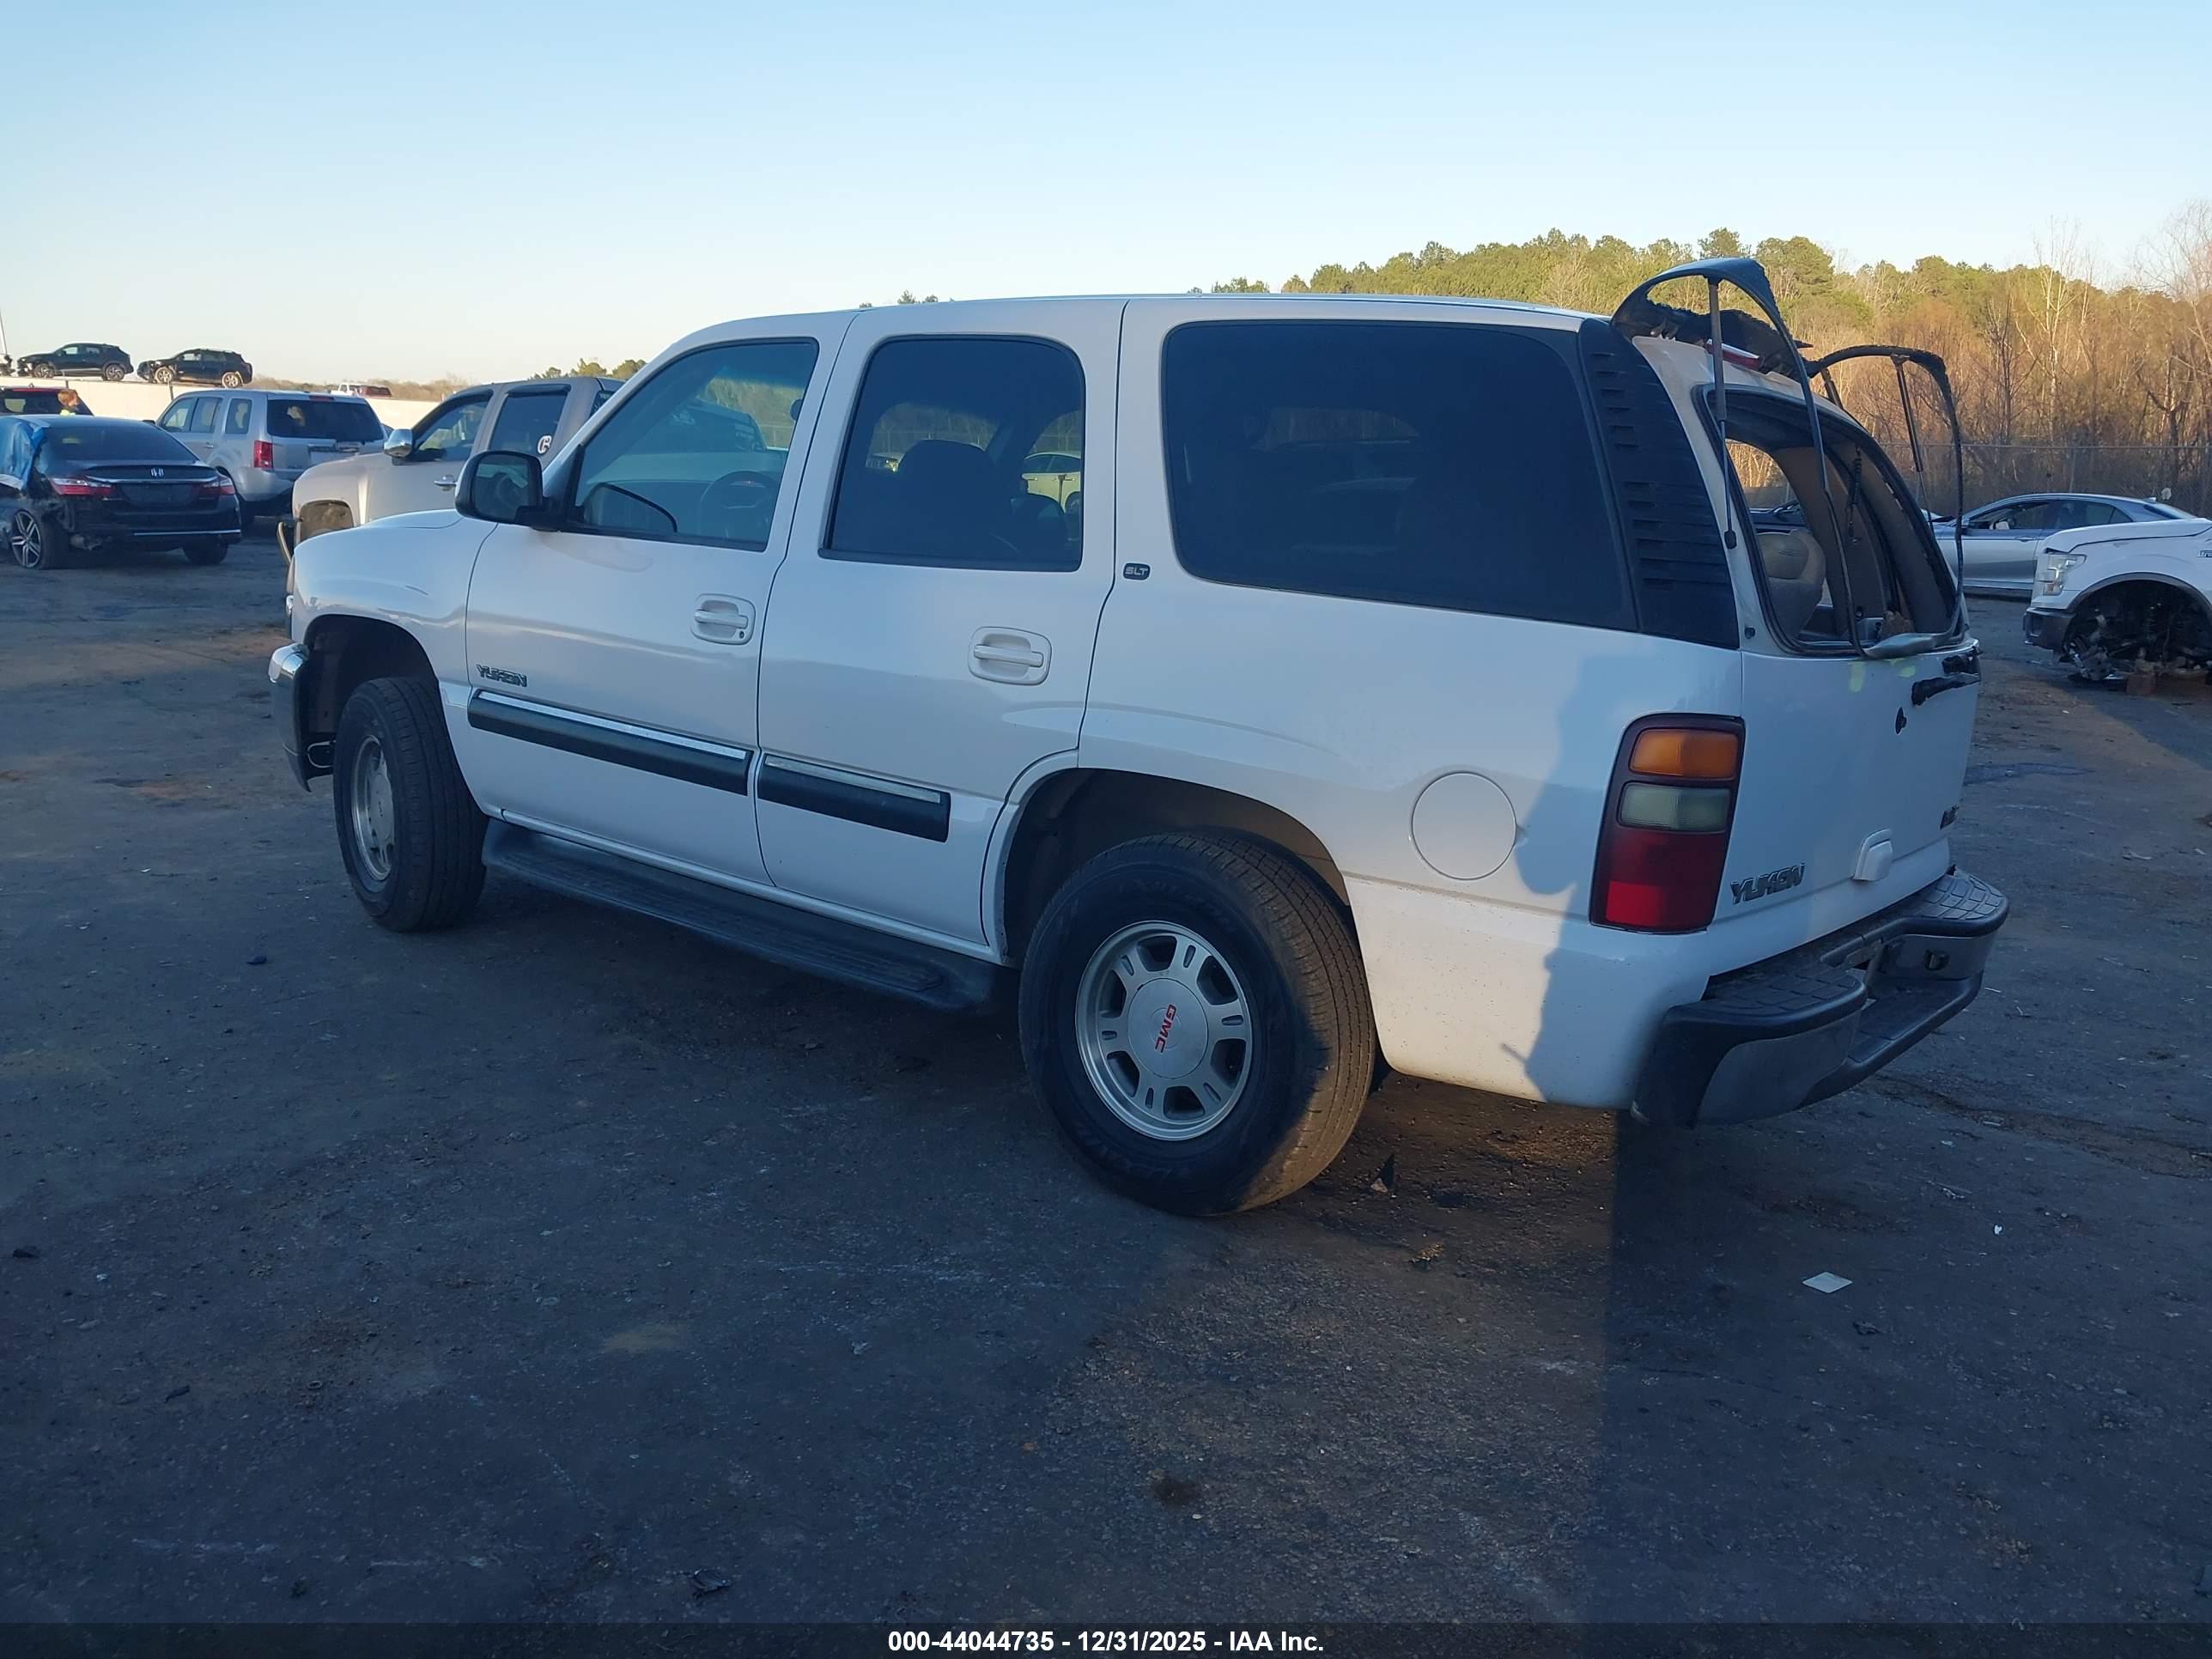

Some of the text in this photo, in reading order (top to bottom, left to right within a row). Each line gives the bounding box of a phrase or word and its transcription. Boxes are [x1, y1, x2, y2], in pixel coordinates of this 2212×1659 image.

[1125, 567, 1148, 575] SLT
[476, 664, 527, 687] YUKON
[1730, 862, 1805, 905] YUKON
[1155, 1004, 1176, 1053] GMC
